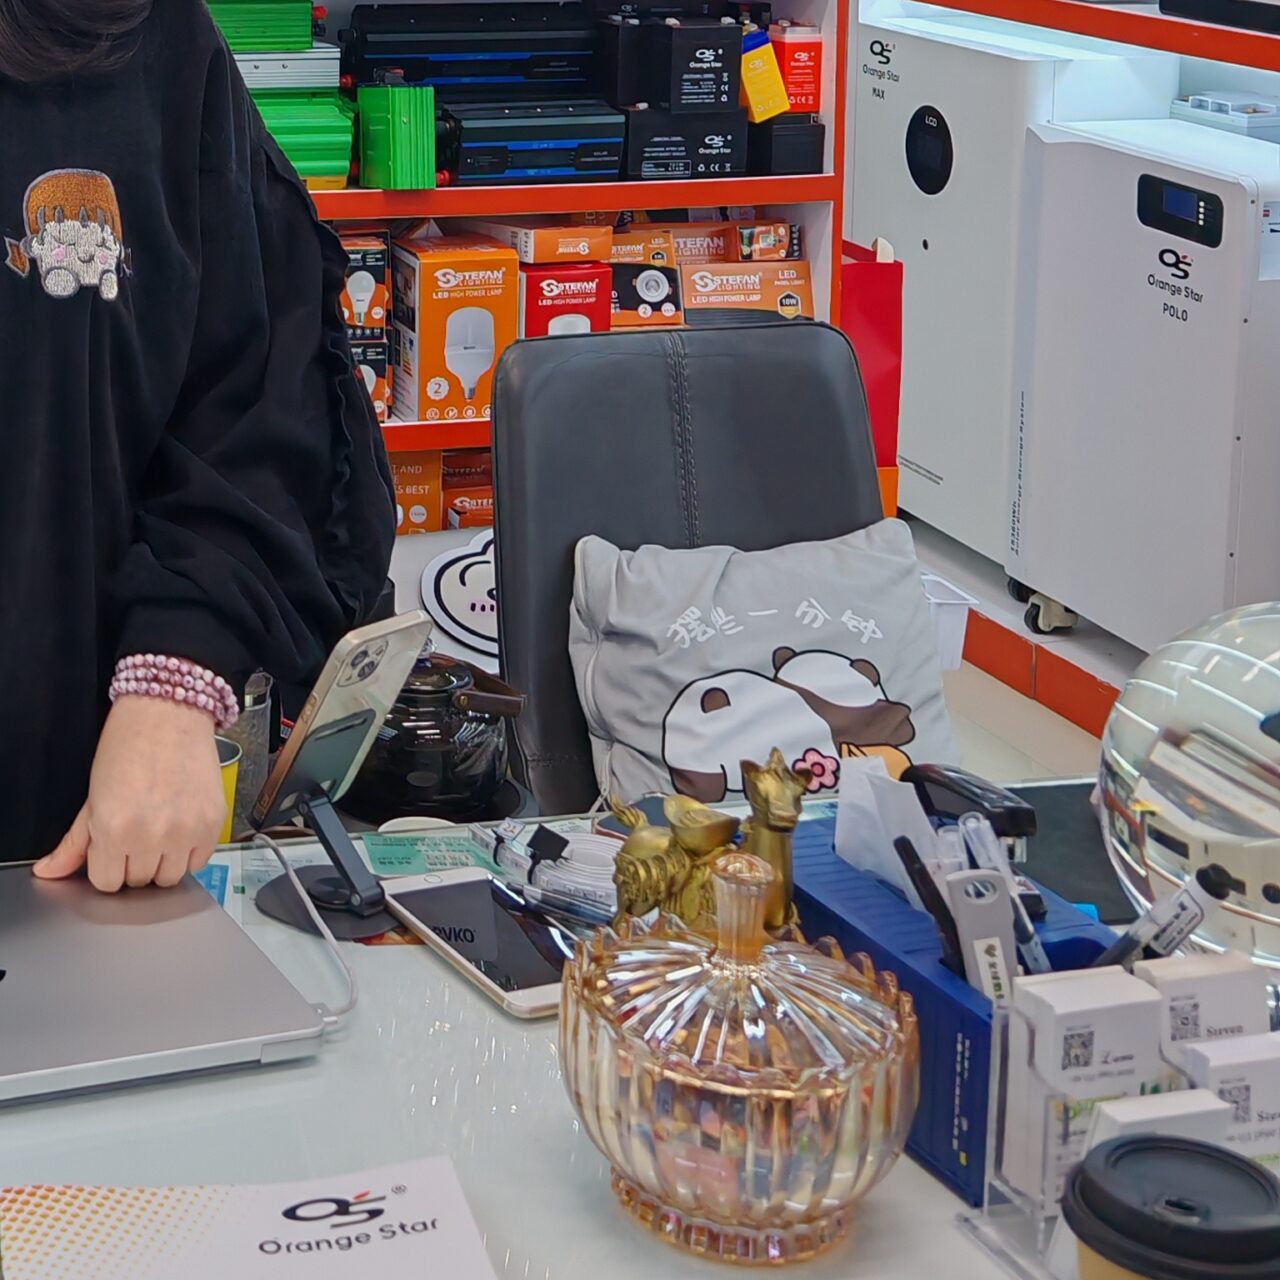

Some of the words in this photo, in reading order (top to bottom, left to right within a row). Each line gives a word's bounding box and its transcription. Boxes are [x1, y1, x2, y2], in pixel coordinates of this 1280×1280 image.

[862, 64, 886, 79] Orange
[886, 70, 900, 84] Star
[872, 87, 885, 101] MAX
[924, 114, 938, 127] LCD
[456, 268, 504, 282] STEFAN
[714, 273, 761, 285] STEFAN
[778, 270, 797, 279] LED
[558, 279, 597, 291] STEFAN
[716, 282, 761, 292] LIGHTING
[1146, 272, 1183, 298] Orange
[1184, 286, 1204, 304] Star
[432, 290, 449, 299] LED
[449, 289, 464, 298] HIGH
[465, 288, 485, 297] POWER
[486, 287, 503, 296] LAMP
[691, 295, 708, 304] LED
[708, 294, 723, 303] HIGH
[723, 294, 744, 302] POWER
[744, 293, 761, 302] LAMP
[538, 297, 552, 306] LED
[553, 297, 566, 305] HIGH
[566, 297, 583, 305] POWER
[583, 296, 597, 304] LAMP
[1162, 302, 1189, 322] POLO
[433, 381, 443, 394] 2
[400, 464, 423, 474] AND
[405, 485, 430, 495] BEST
[258, 1228, 372, 1257] Orange
[378, 1217, 440, 1241] Star
